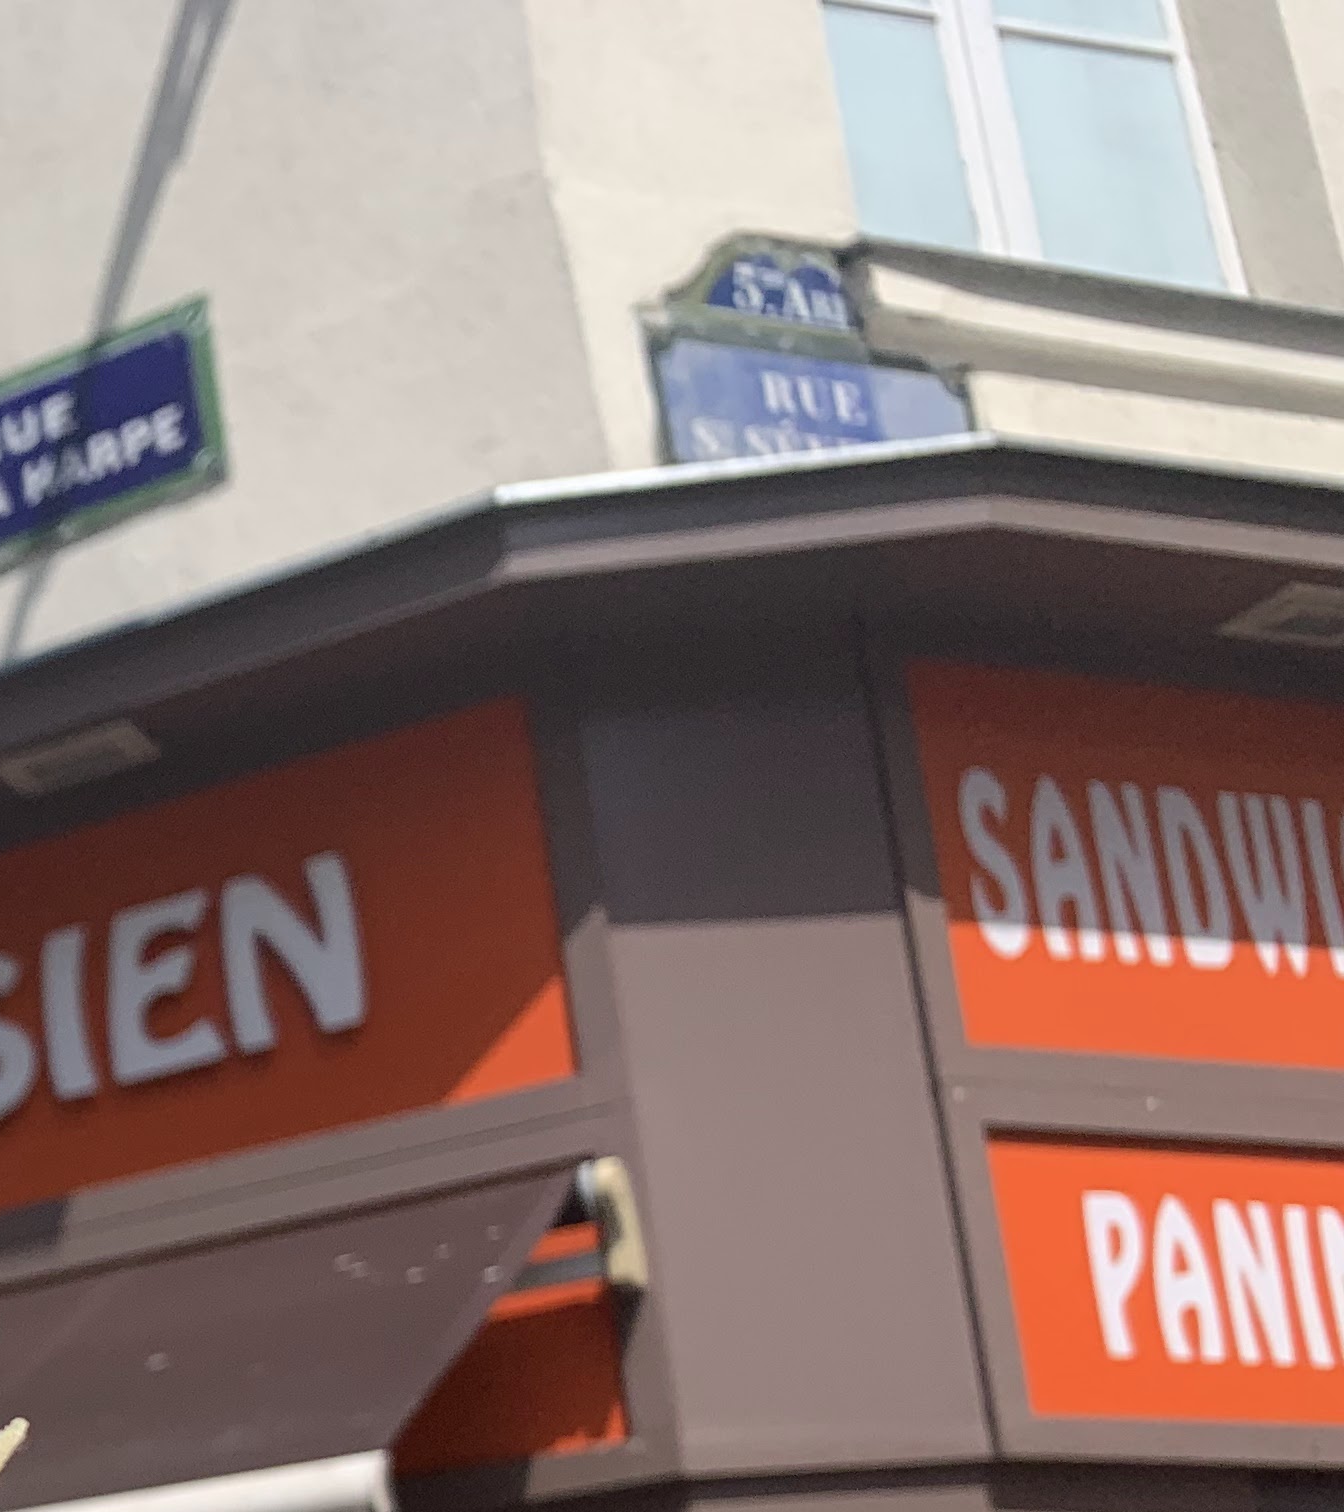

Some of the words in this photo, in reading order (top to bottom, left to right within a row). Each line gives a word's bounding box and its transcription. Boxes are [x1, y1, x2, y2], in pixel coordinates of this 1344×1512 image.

[19, 400, 189, 508] HARPE
[761, 369, 867, 427] RUE
[955, 766, 1344, 980] SANDWI
[1080, 1188, 1344, 1370] PANI
